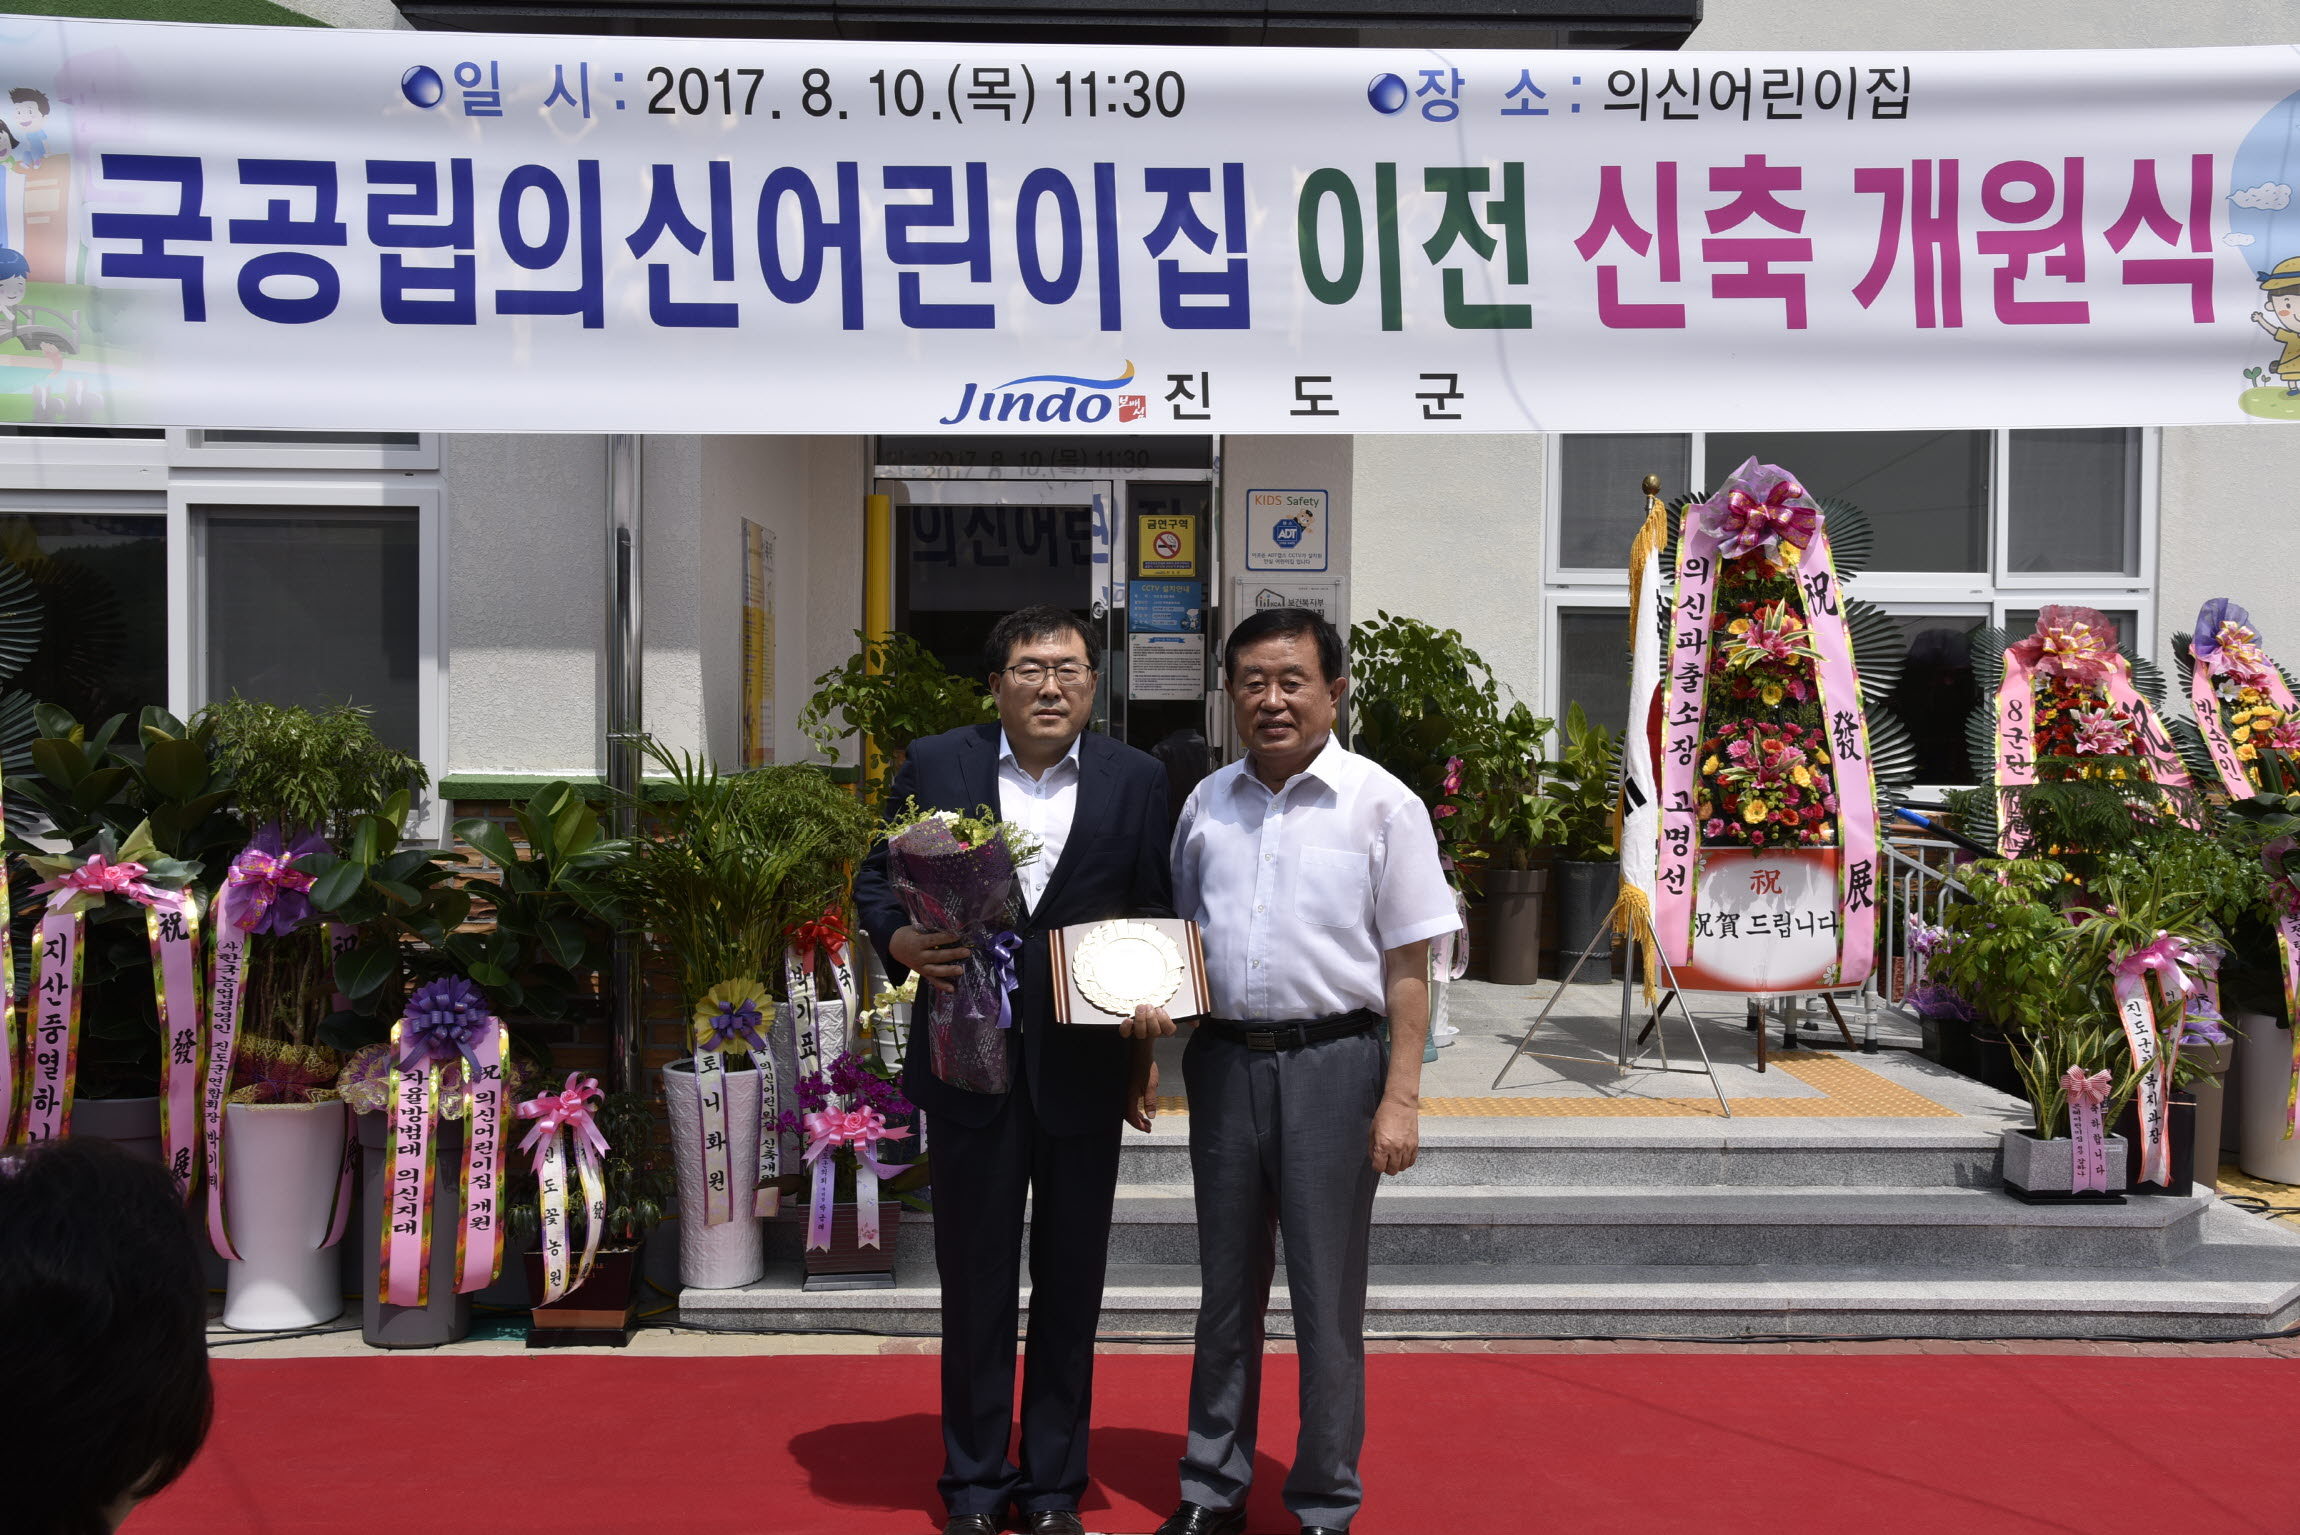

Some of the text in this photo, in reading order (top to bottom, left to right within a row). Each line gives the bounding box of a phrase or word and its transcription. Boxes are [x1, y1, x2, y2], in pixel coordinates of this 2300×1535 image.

[453, 60, 503, 117] 일
[646, 67, 781, 119] 2017.
[801, 68, 848, 120] 8.
[1055, 70, 1185, 119] 11:30
[1414, 67, 1465, 123] 장
[1603, 65, 1912, 121] 의신어린이집
[92, 153, 2215, 331] 국공립의신어린이집 이전 신축 개원식
[939, 382, 1112, 425] Jindo
[1254, 494, 1320, 508] KIDS Safety
[1146, 519, 1189, 530] 금연구역
[1277, 528, 1298, 539] ADT
[1162, 585, 1191, 593] 설치안내
[1287, 598, 1325, 608] 보건복지부
[1658, 556, 1711, 896] 의신파출소장 고명선
[1749, 868, 1783, 896] 祝
[1746, 910, 1840, 939] 드립니다
[392, 1069, 430, 1237] 자율방범대 의신지대
[468, 1090, 497, 1191] 의신어린이집
[468, 1198, 493, 1232] 개원
